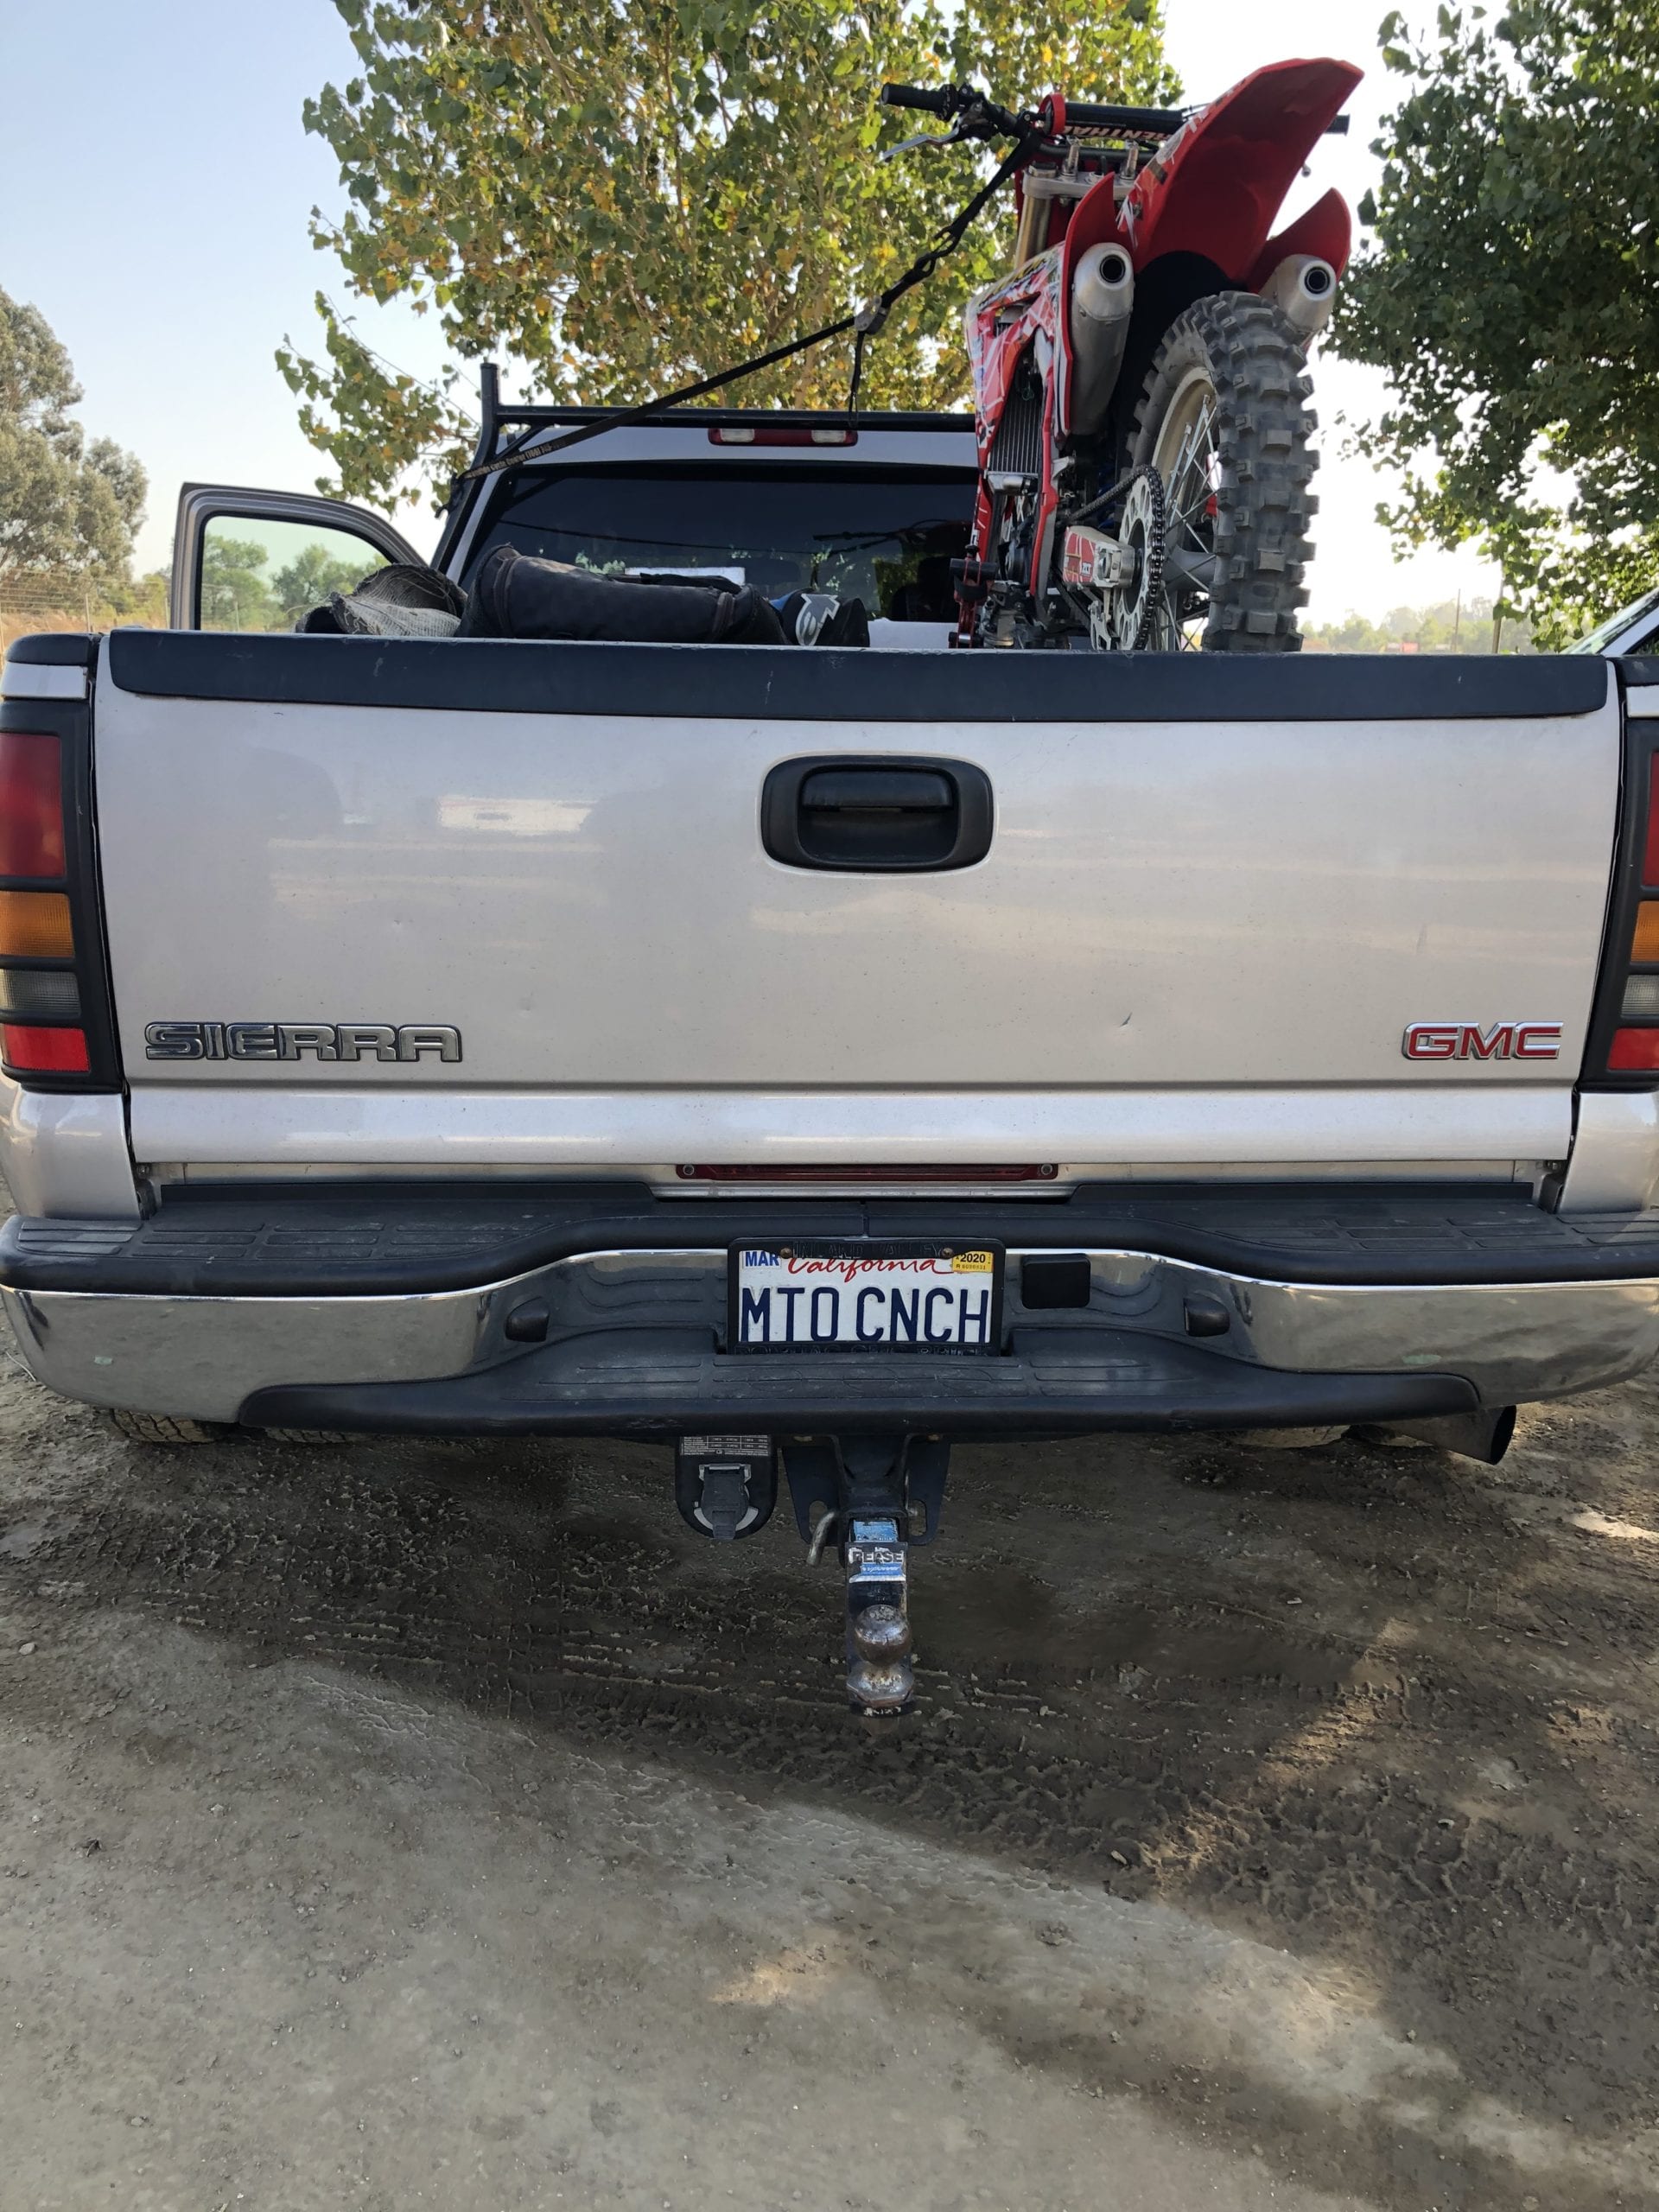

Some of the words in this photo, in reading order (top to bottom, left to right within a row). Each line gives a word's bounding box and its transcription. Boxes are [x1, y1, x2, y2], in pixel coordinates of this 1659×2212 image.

[145, 1022, 462, 1062] SIERRA
[1402, 1021, 1563, 1060] GMC
[746, 1251, 779, 1267] MAR
[788, 1257, 954, 1282] California
[960, 1253, 986, 1263] 2020
[741, 1287, 840, 1341] MTO
[855, 1287, 989, 1343] CNCH
